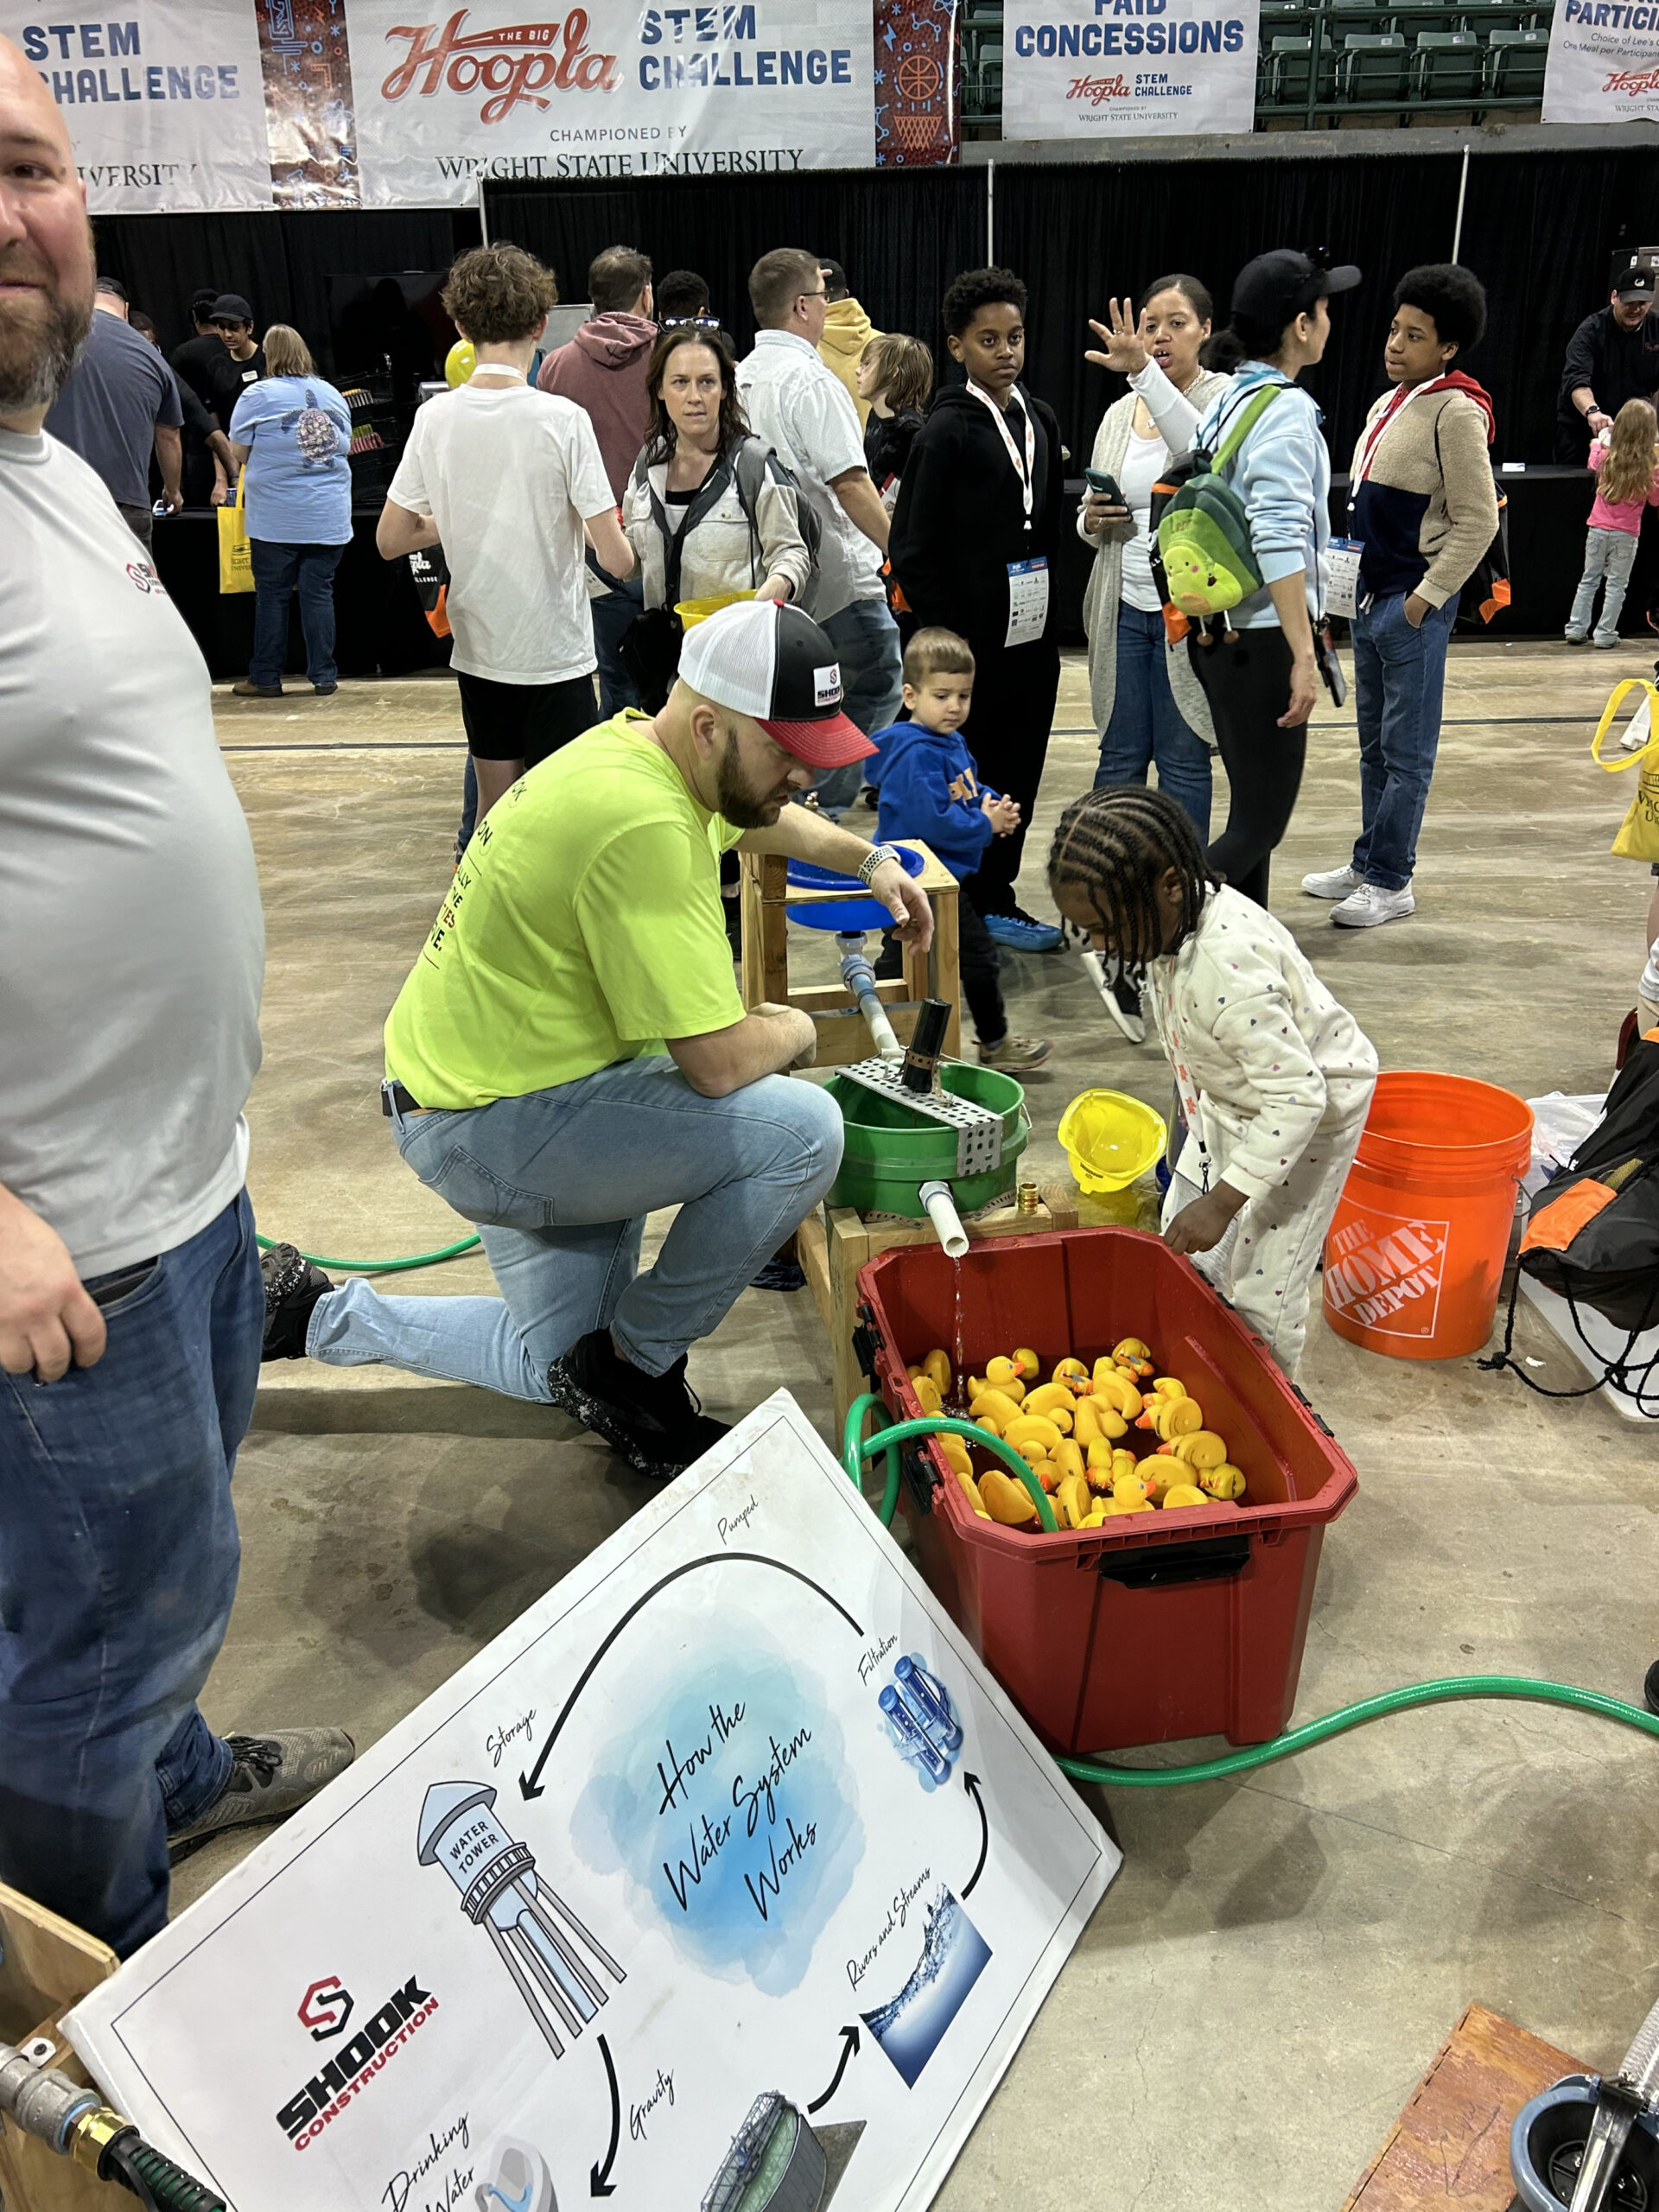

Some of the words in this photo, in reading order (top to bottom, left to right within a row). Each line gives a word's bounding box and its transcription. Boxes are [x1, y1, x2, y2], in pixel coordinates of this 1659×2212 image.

[498, 31, 523, 41] THE
[529, 29, 550, 41] BIG
[639, 5, 757, 45] STEM
[1565, 0, 1659, 30] PARTICI
[22, 22, 141, 61] STEM
[1015, 20, 1244, 57] CONCESSIONS
[1563, 40, 1578, 50] One
[1579, 43, 1599, 53] Meal
[1591, 33, 1619, 44] Choice
[1632, 37, 1654, 46] Lee's
[38, 66, 240, 105] HALLENGE
[381, 8, 624, 125] Hoopla
[639, 49, 852, 91] CHALLENGE
[1135, 73, 1168, 85] STEM
[1065, 73, 1131, 106] Hoopla
[1135, 85, 1192, 97] CHALLENGE
[550, 127, 661, 142] CHAMPIONED
[556, 154, 633, 177] STATE
[639, 149, 804, 175] UNIVERSITY
[1332, 1219, 1375, 1255] THE
[1325, 1221, 1446, 1311] HOME
[1353, 1265, 1440, 1326] DEPOT
[717, 1494, 759, 1545] Pumped
[857, 1634, 898, 1687] Filtration
[486, 1708, 537, 1768] Storage
[658, 1734, 712, 1815] How
[709, 1702, 746, 1744] the
[663, 1814, 731, 1911] Water
[733, 1728, 812, 1837] System
[449, 1821, 489, 1860] WATER
[458, 1834, 499, 1874] TOWER
[744, 1818, 817, 1922] Works
[846, 1944, 878, 1992] Rivers
[878, 1911, 897, 1946] and
[893, 1867, 931, 1928] Streams
[276, 1974, 432, 2140] SHOOK
[295, 1997, 439, 2151] CONSTRUCTION
[630, 2069, 674, 2140] Gravity
[382, 2112, 469, 2212] Drinking
[425, 2166, 474, 2212] Water
